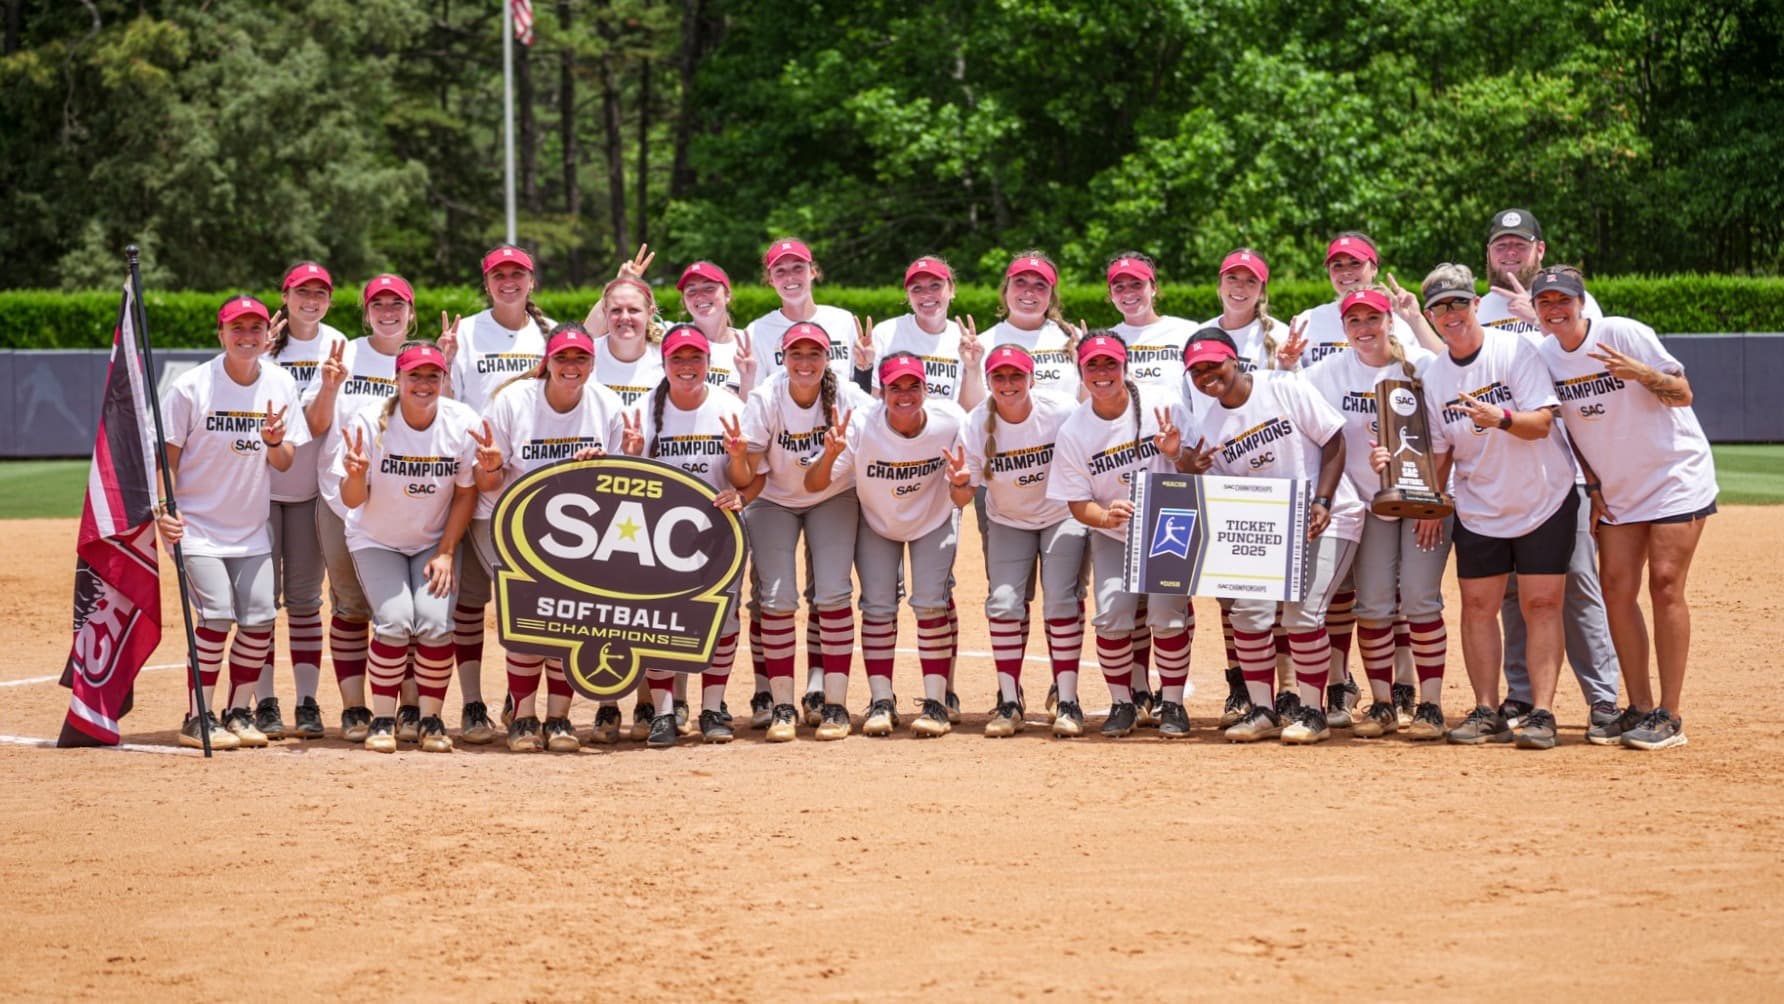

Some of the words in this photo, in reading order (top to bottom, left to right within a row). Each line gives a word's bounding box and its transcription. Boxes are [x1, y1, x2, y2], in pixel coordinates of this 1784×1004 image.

[1035, 369, 1060, 380] SAC
[1135, 367, 1161, 378] SAC
[344, 381, 394, 397] CHAMP
[1555, 376, 1625, 401] HAMPIONS
[1395, 396, 1415, 406] SAC
[1580, 403, 1605, 417] SAC
[206, 416, 264, 433] CHAMPI
[235, 439, 261, 451] SAC
[656, 440, 728, 457] HAMPION
[1222, 420, 1292, 464] CHAMPIONS
[1250, 451, 1275, 468] SAC
[682, 462, 708, 473] SAC
[1019, 472, 1044, 485] SAC
[408, 483, 436, 494] SAC
[595, 474, 663, 499] 2025
[896, 482, 921, 496] SAC
[538, 493, 713, 573] SAC
[1226, 520, 1276, 533] TICKET
[1217, 531, 1282, 545] PUNCHED
[1231, 545, 1267, 557] 2025
[536, 597, 686, 632] SOFTBALL
[548, 622, 669, 645] CHAMPIONS
